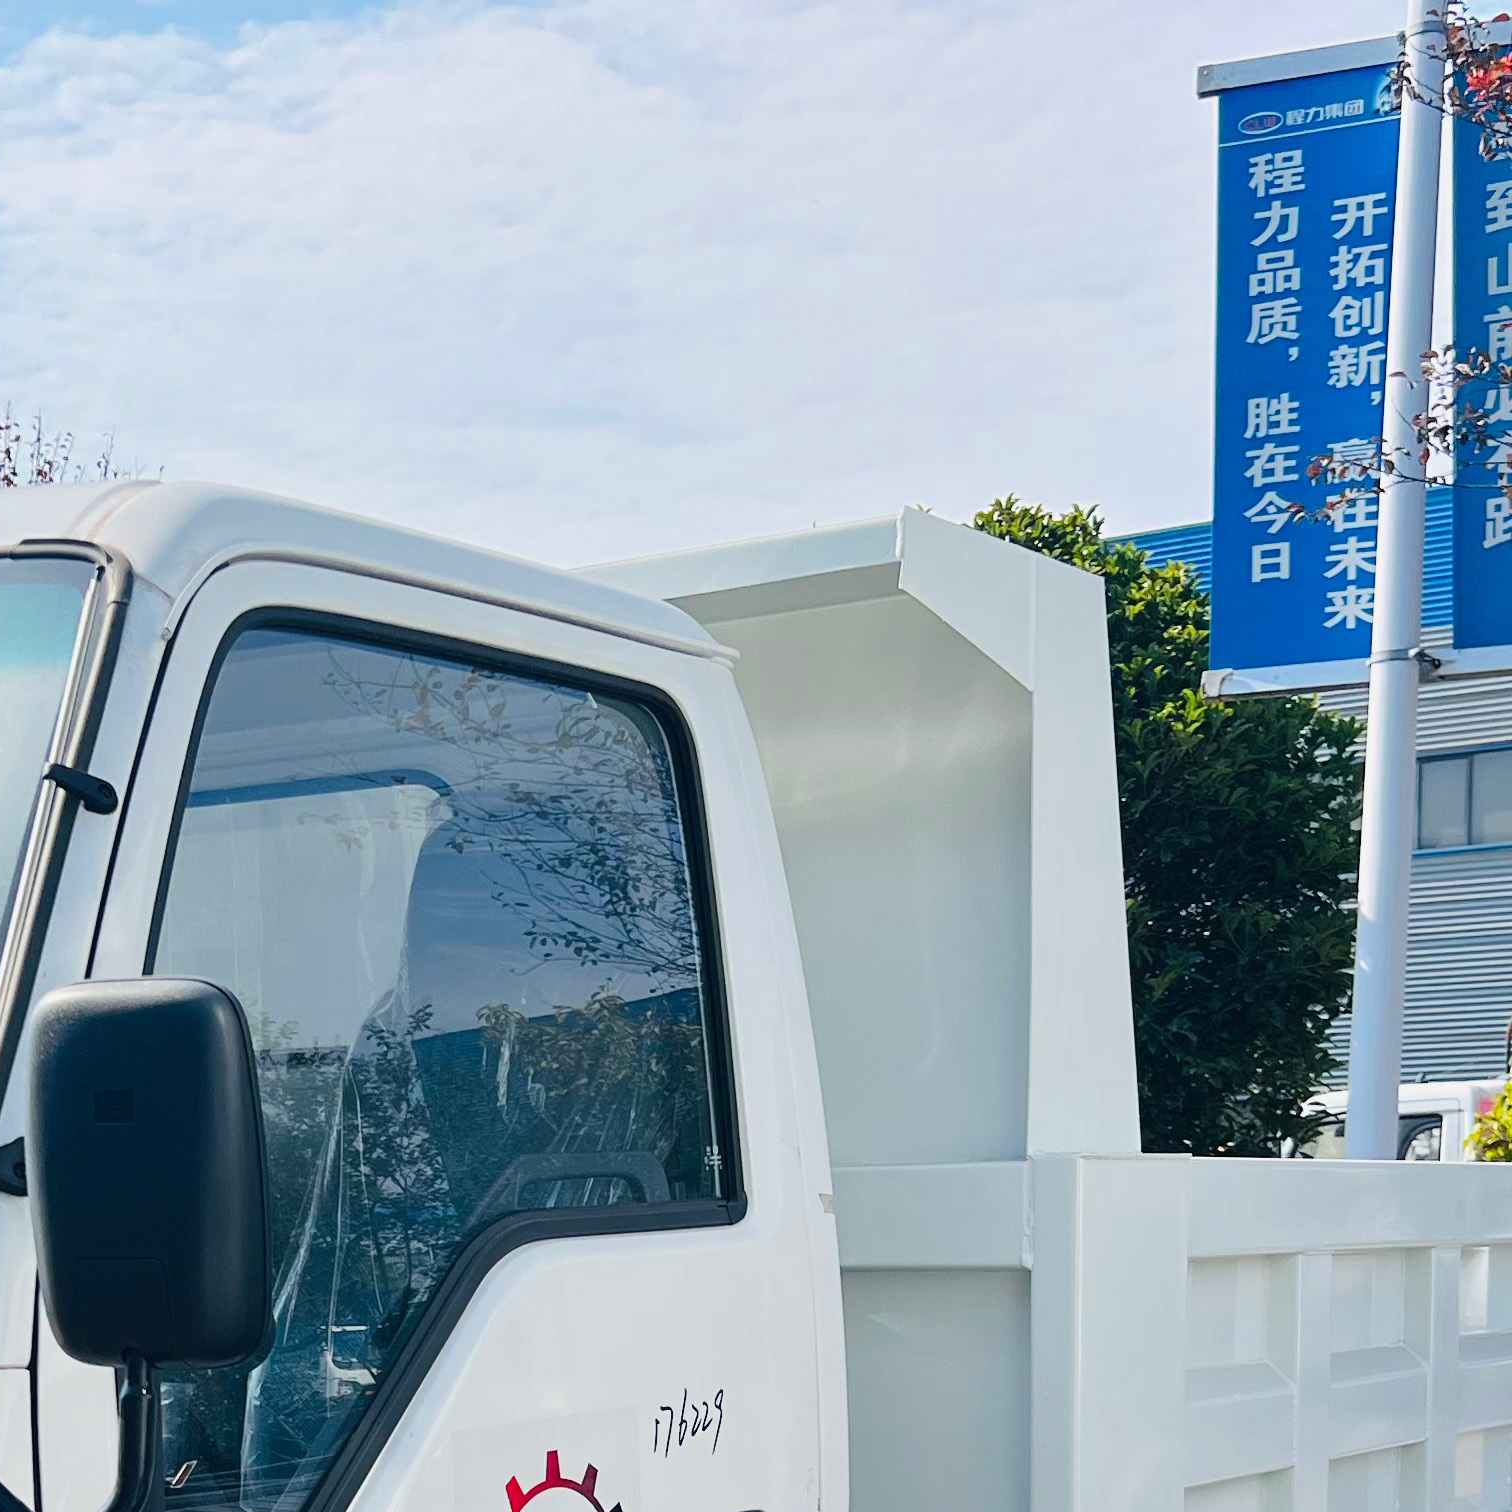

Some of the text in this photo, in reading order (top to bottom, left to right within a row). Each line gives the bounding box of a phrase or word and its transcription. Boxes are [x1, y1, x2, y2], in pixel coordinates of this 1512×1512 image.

[1285, 99, 1365, 126] 程力集团
[653, 1387, 724, 1458] 176229
